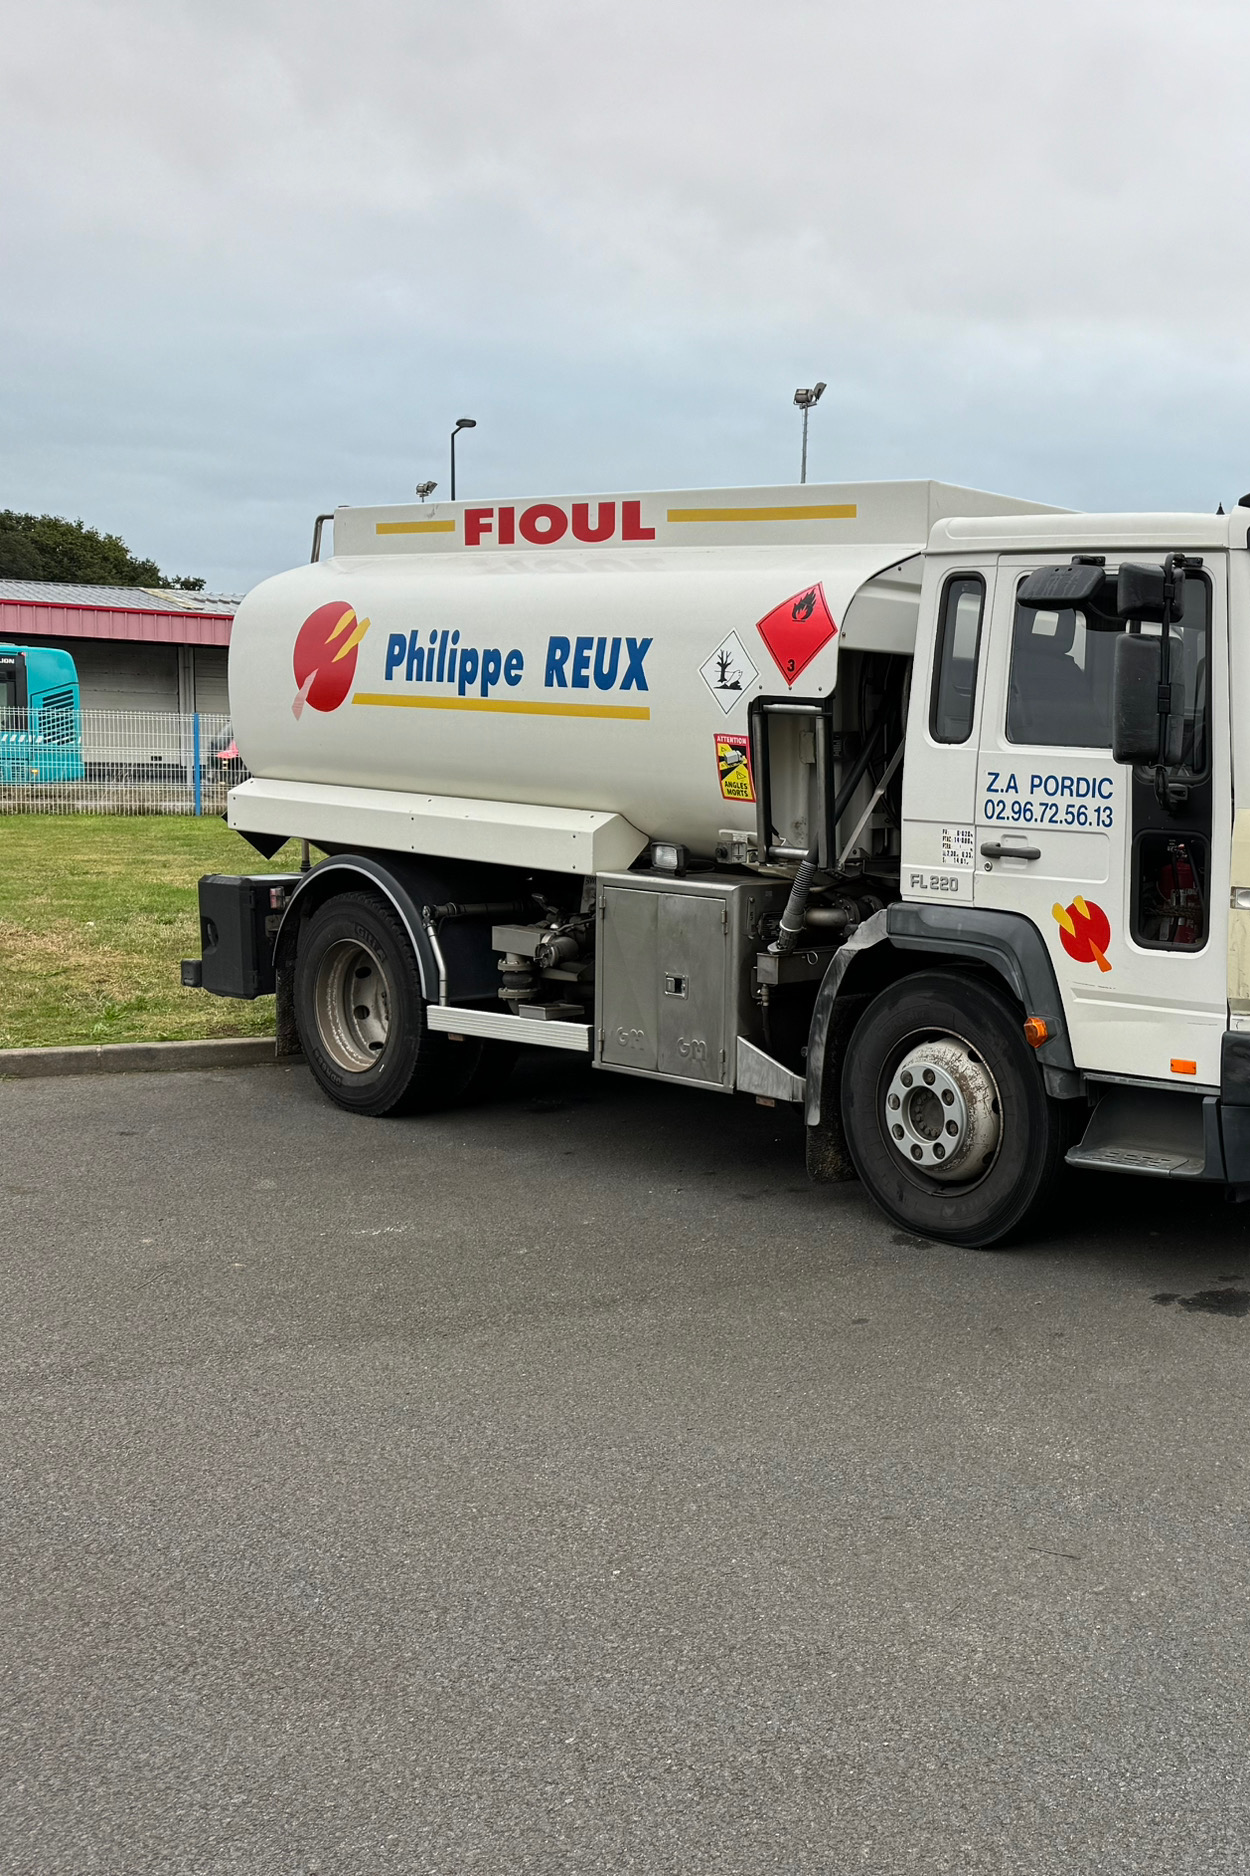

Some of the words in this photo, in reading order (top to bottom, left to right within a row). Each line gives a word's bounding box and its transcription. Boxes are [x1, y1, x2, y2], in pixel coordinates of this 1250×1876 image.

[464, 500, 656, 546] FIOUL
[384, 629, 524, 697] Philippe
[544, 636, 653, 691] REUX
[787, 659, 795, 672] 3
[716, 735, 747, 745] ATTENTION
[724, 781, 748, 790] ANGLES
[726, 788, 749, 797] MORTS
[986, 772, 1019, 794] Z.A
[1029, 774, 1114, 800] PORDIC
[984, 799, 1113, 828] 02.96.72.56.13
